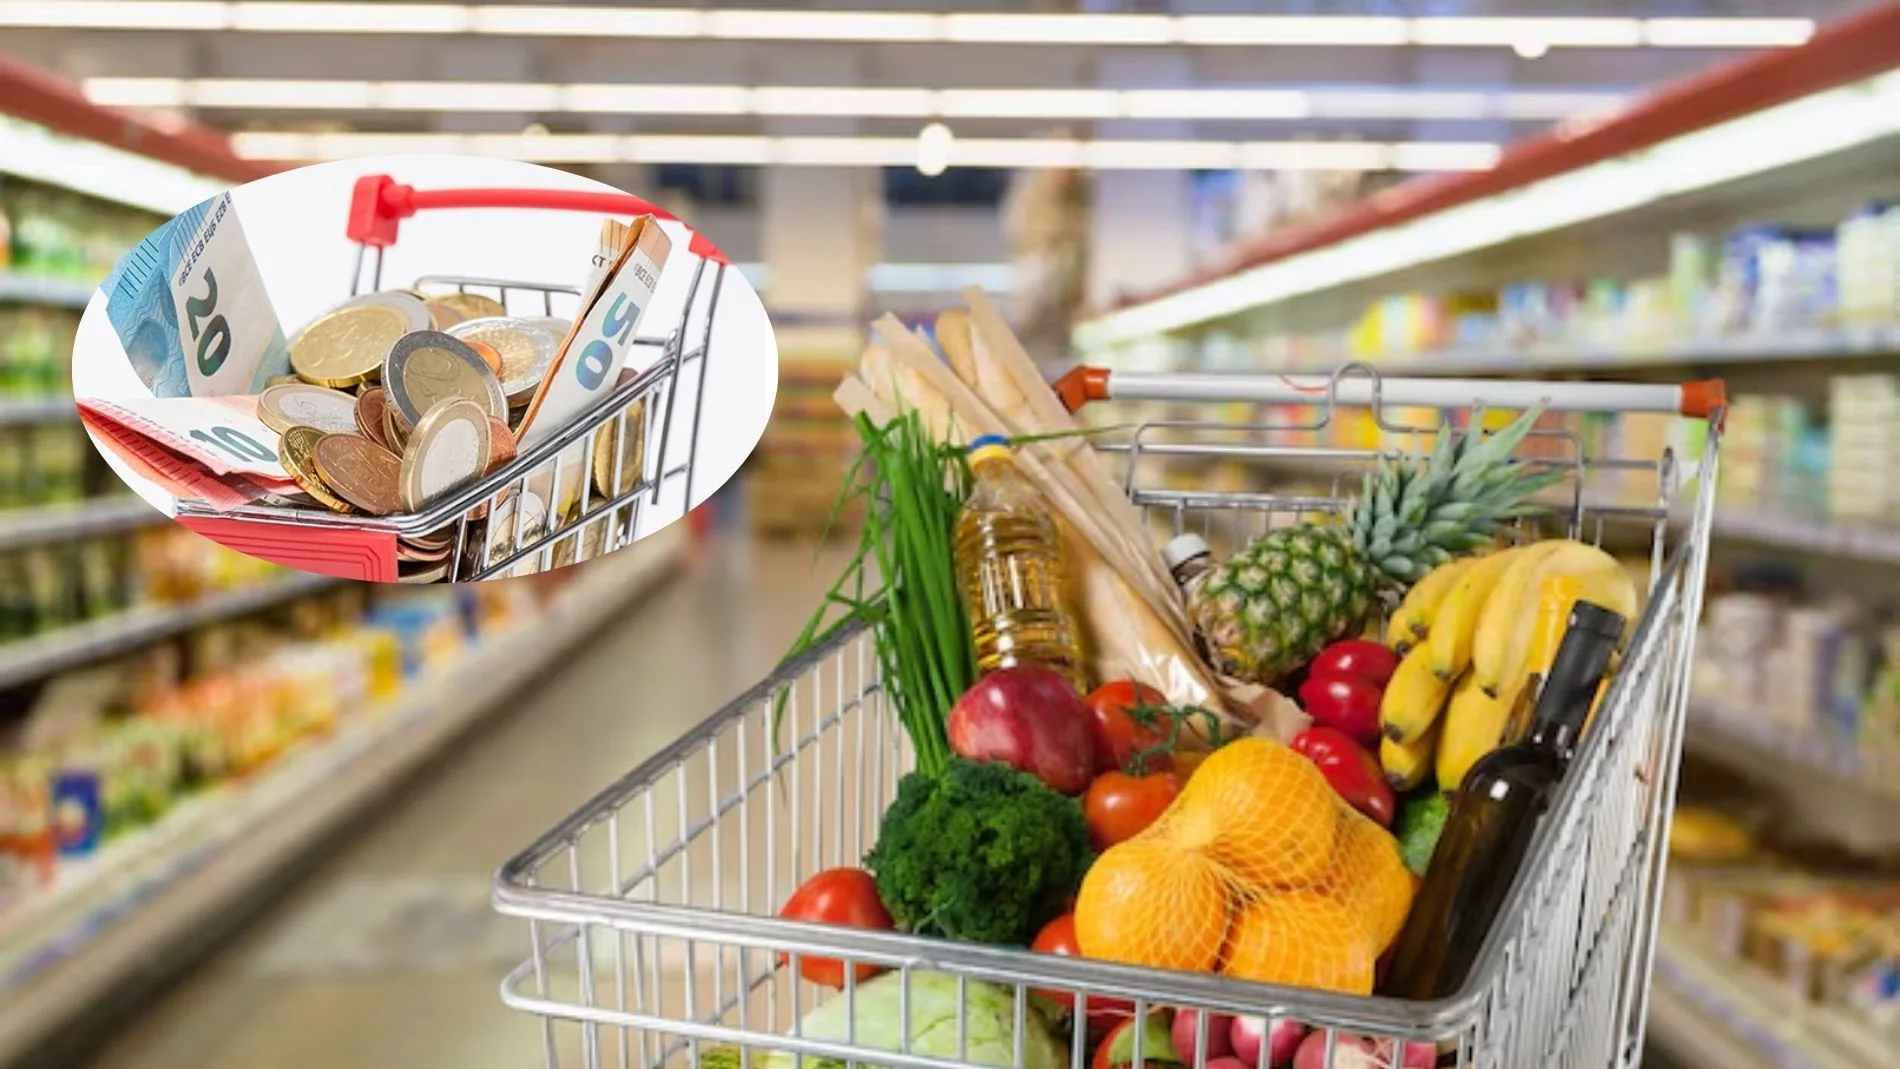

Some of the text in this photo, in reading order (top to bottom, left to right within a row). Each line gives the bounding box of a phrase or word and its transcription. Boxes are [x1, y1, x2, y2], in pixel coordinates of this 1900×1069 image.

[186, 266, 231, 377] 20
[576, 291, 641, 391] 50
[189, 426, 278, 463] 10
